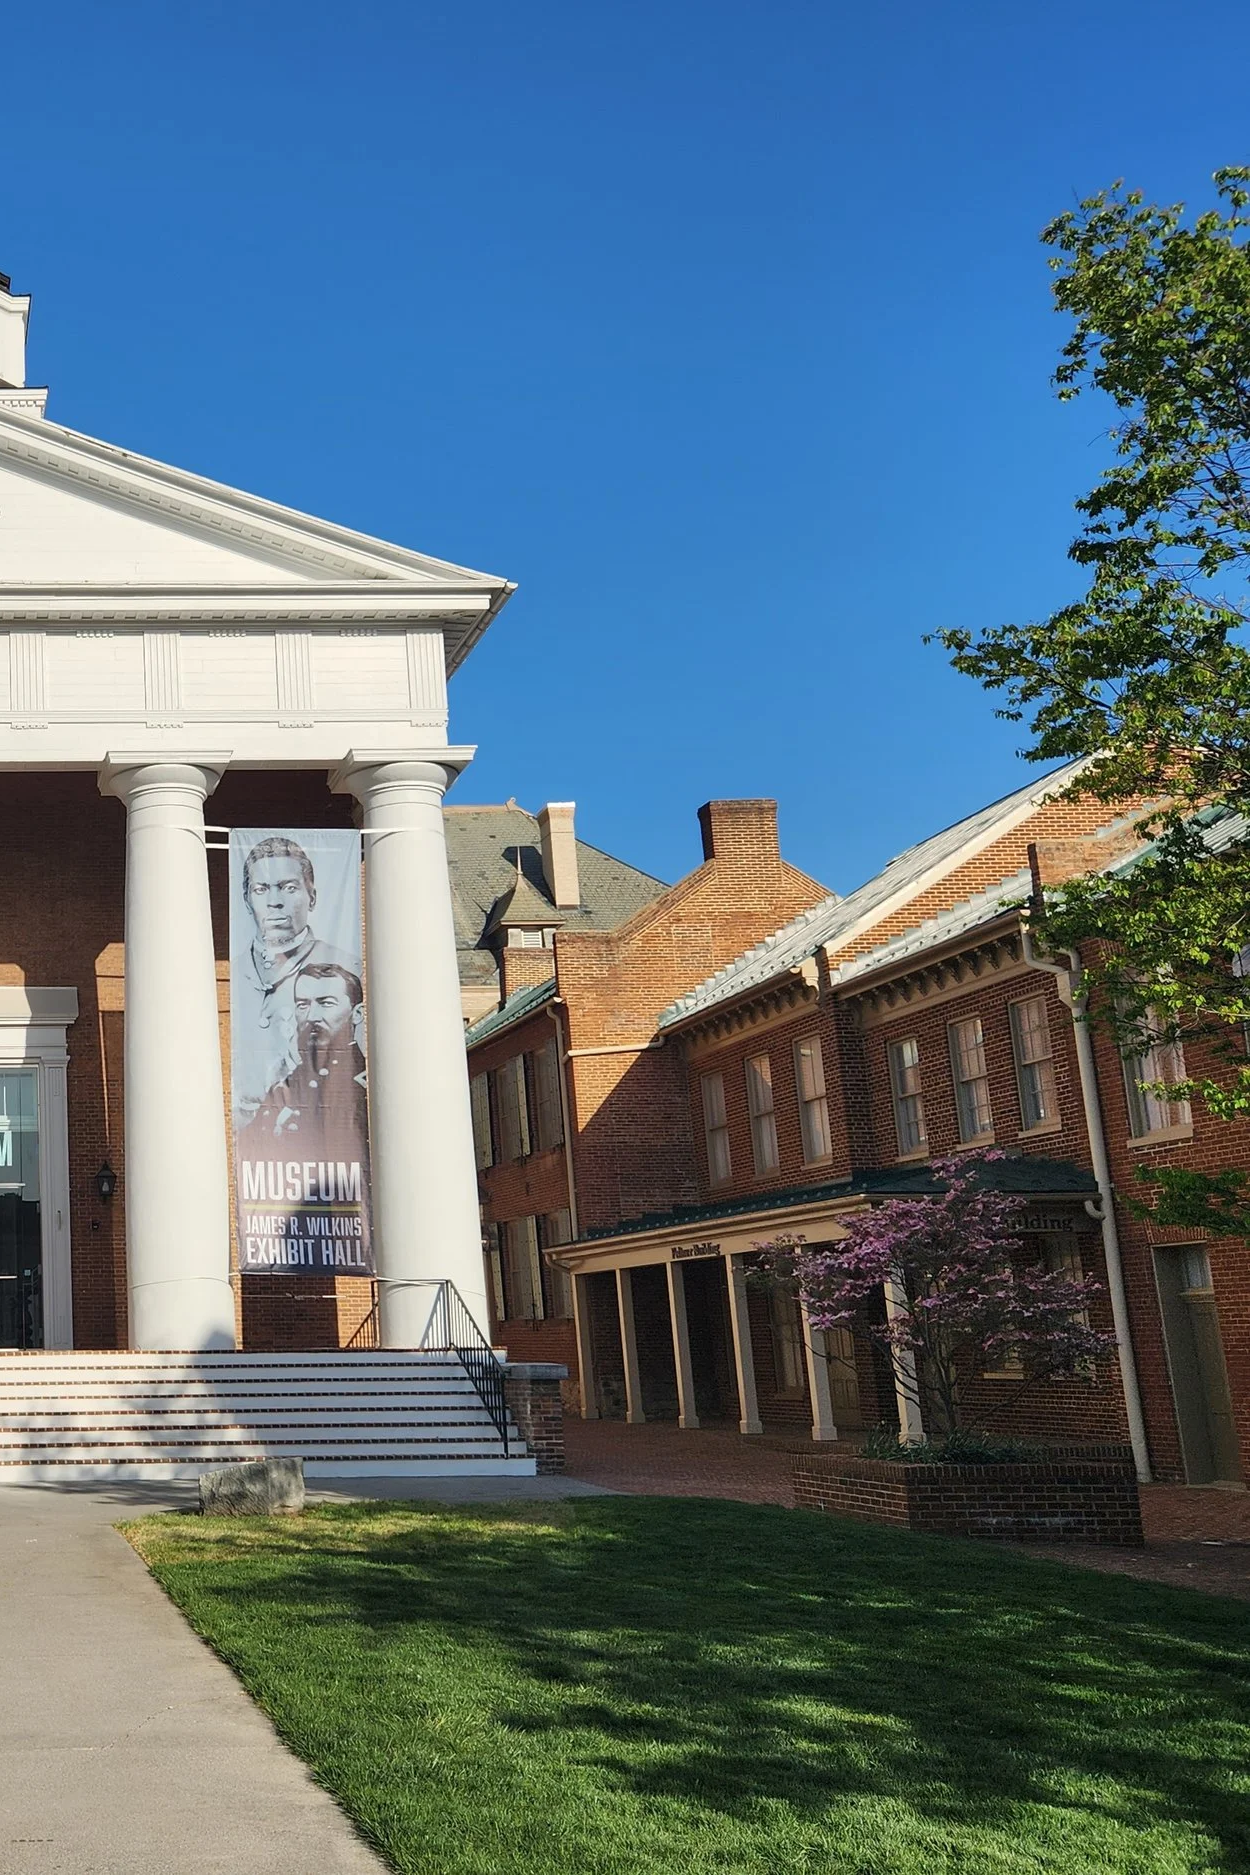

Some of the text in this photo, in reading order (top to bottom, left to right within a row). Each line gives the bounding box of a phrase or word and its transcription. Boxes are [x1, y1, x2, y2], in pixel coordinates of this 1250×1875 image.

[242, 1160, 362, 1202] MUSEUM
[245, 1215, 362, 1237] JAMES R. WILKINS
[246, 1237, 366, 1267] EXHIBIT HALL
